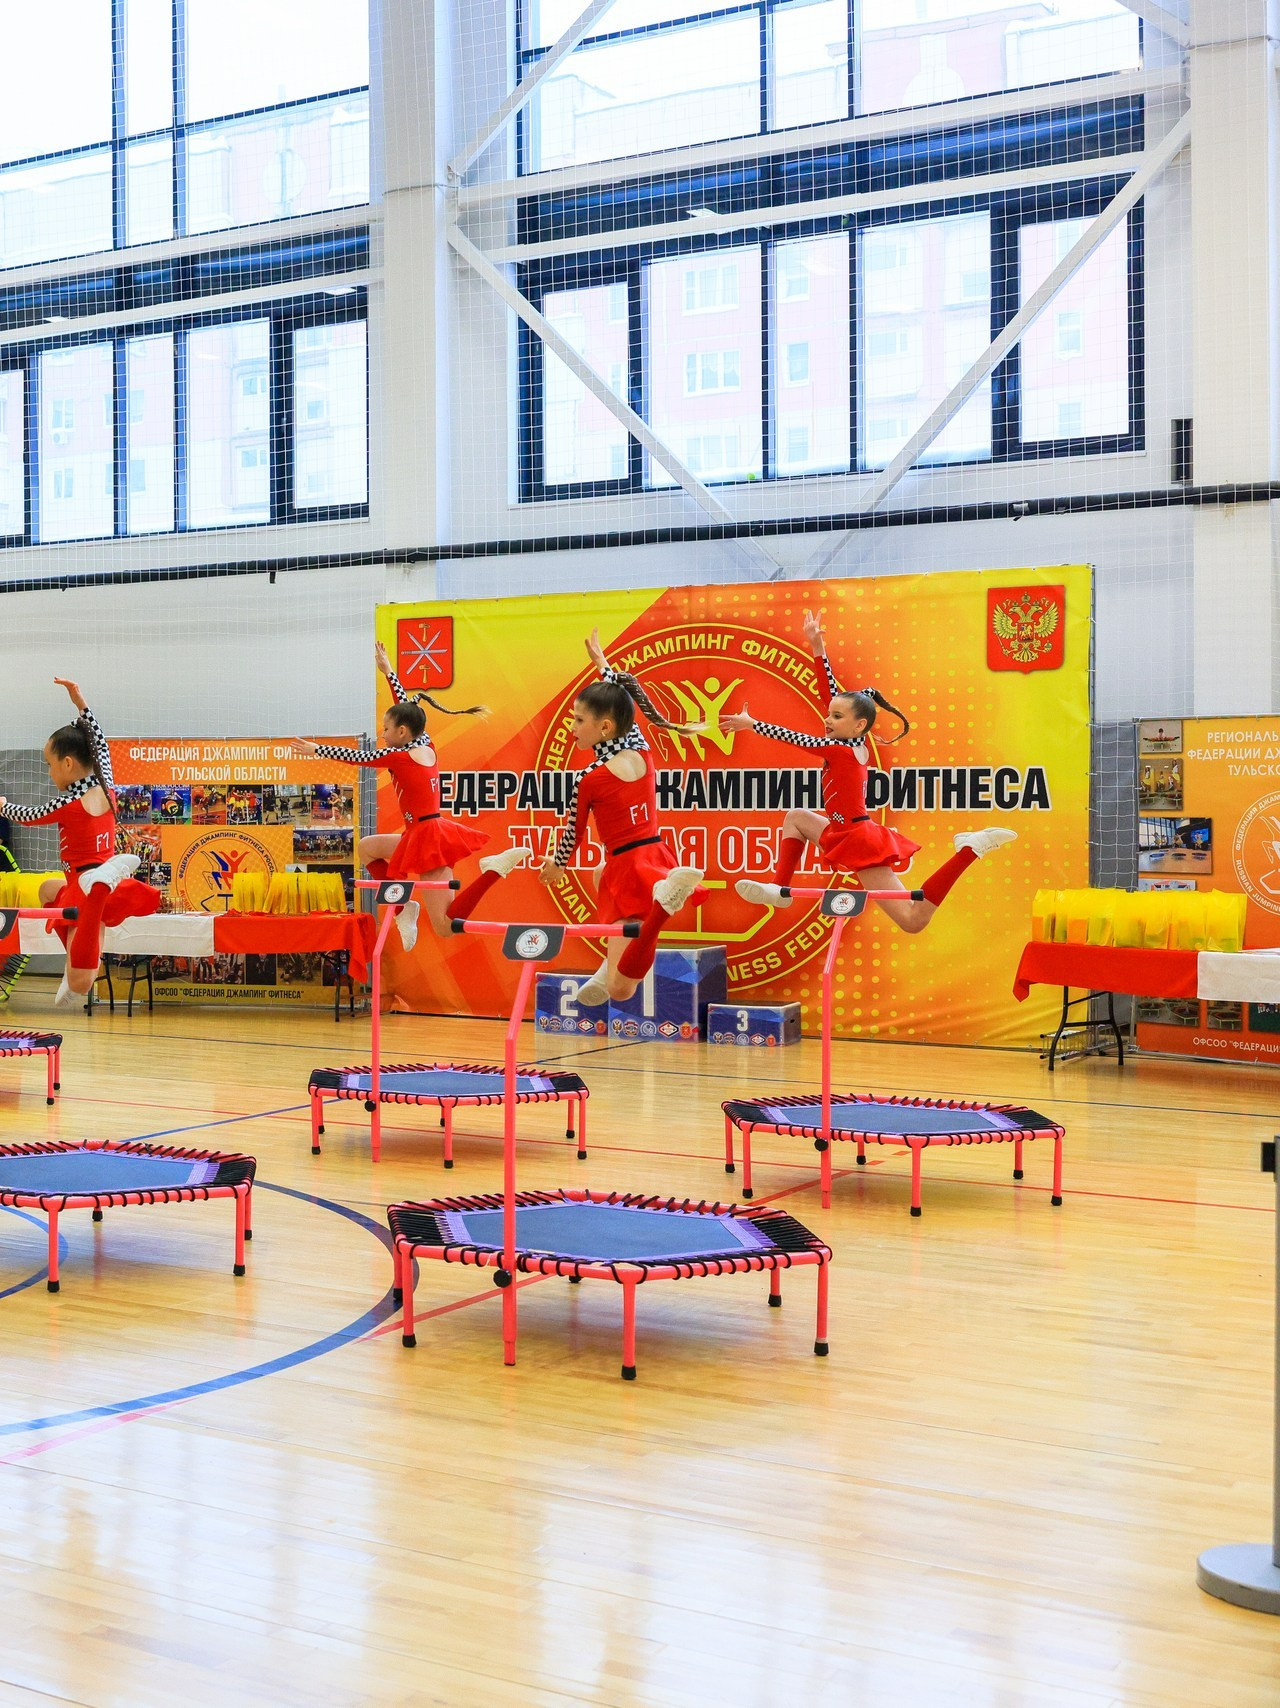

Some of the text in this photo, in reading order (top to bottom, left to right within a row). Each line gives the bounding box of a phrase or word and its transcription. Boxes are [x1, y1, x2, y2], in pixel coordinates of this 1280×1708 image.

[741, 639, 822, 698] ФИТНЕС
[129, 746, 199, 763] ФЕДЕРАЦИЯ
[202, 746, 270, 762] ДЖАМПИНГ
[1187, 748, 1261, 760] ФЕДЕРАЦИИ
[171, 765, 287, 781] ТУЛЬСКОЙ ОБЛАСТИ
[438, 770, 583, 817] ЕДЕРАЦ
[656, 768, 825, 812] ЖАМПИН
[629, 802, 649, 825] F1
[1235, 807, 1258, 851] ФЕДЕРАЦИЯ
[96, 832, 109, 853] F1
[179, 842, 200, 879] ФЕДЕРАЦИЯ
[200, 832, 237, 846] ДЖАМПИНГ
[238, 834, 265, 855] ФИТНЕСА
[1235, 859, 1280, 912] RUSSIAN JUMPIN
[154, 987, 178, 997] ОФСОО
[226, 989, 267, 999] ДЖАМПИНГ
[268, 990, 304, 999] ФИТНЕСА"
[560, 979, 579, 1017] 2
[736, 1010, 749, 1032] 3
[1192, 1036, 1228, 1048] ОФСОО
